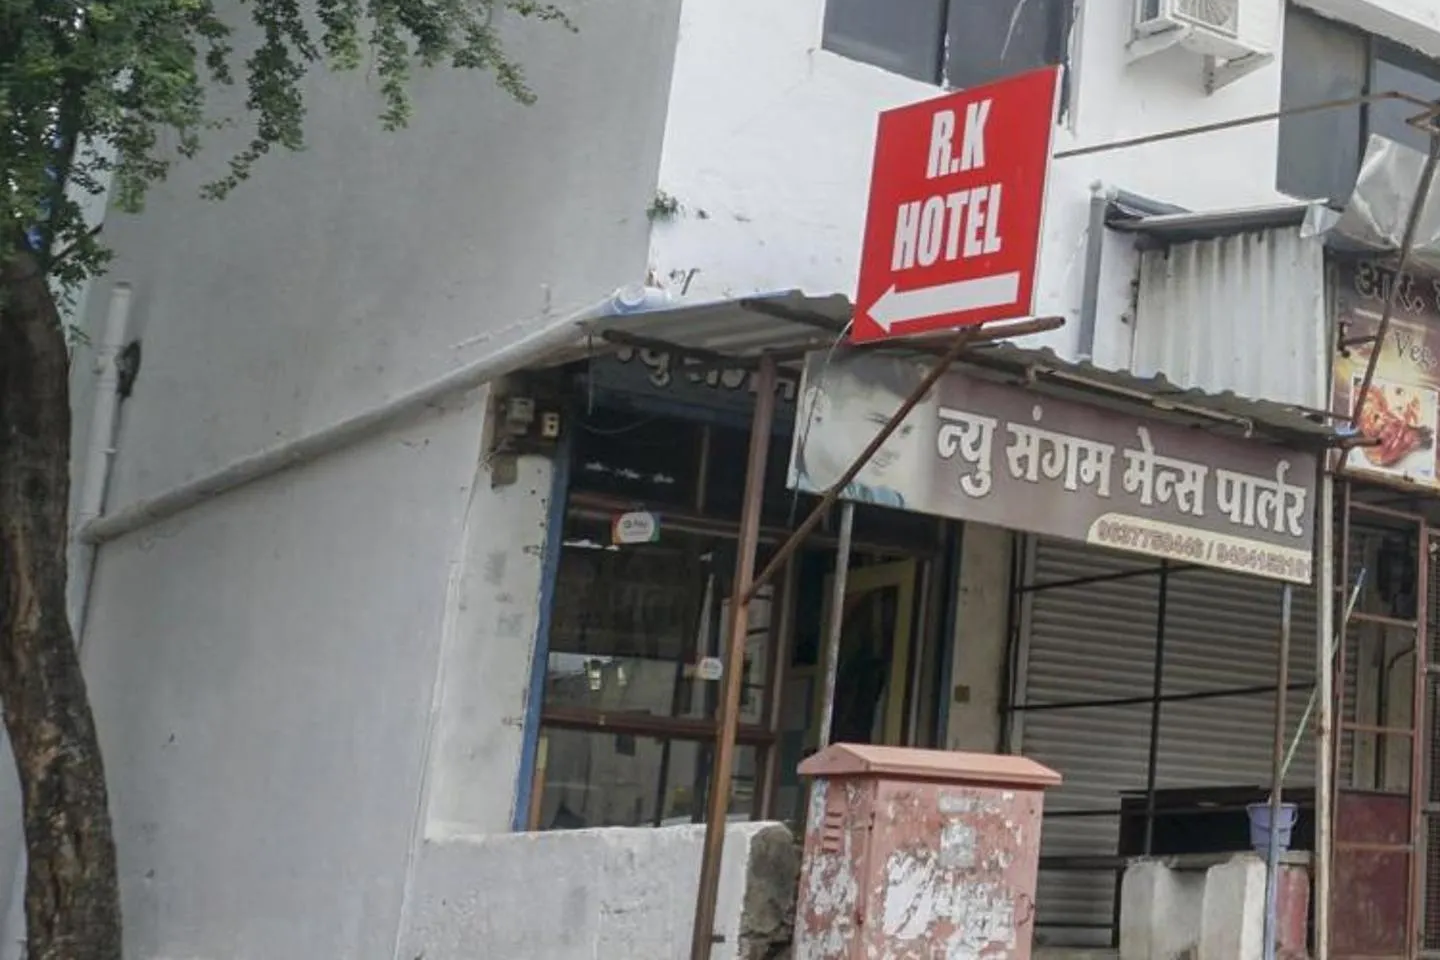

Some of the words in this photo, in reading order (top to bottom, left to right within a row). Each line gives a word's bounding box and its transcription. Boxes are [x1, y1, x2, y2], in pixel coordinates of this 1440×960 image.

[926, 98, 993, 179] R.K
[890, 183, 1002, 272] HOTEL
[937, 406, 997, 497] न्यु
[1006, 405, 1116, 497] संगम
[1122, 427, 1208, 516] मेन्स
[1215, 460, 1307, 537] पार्लर
